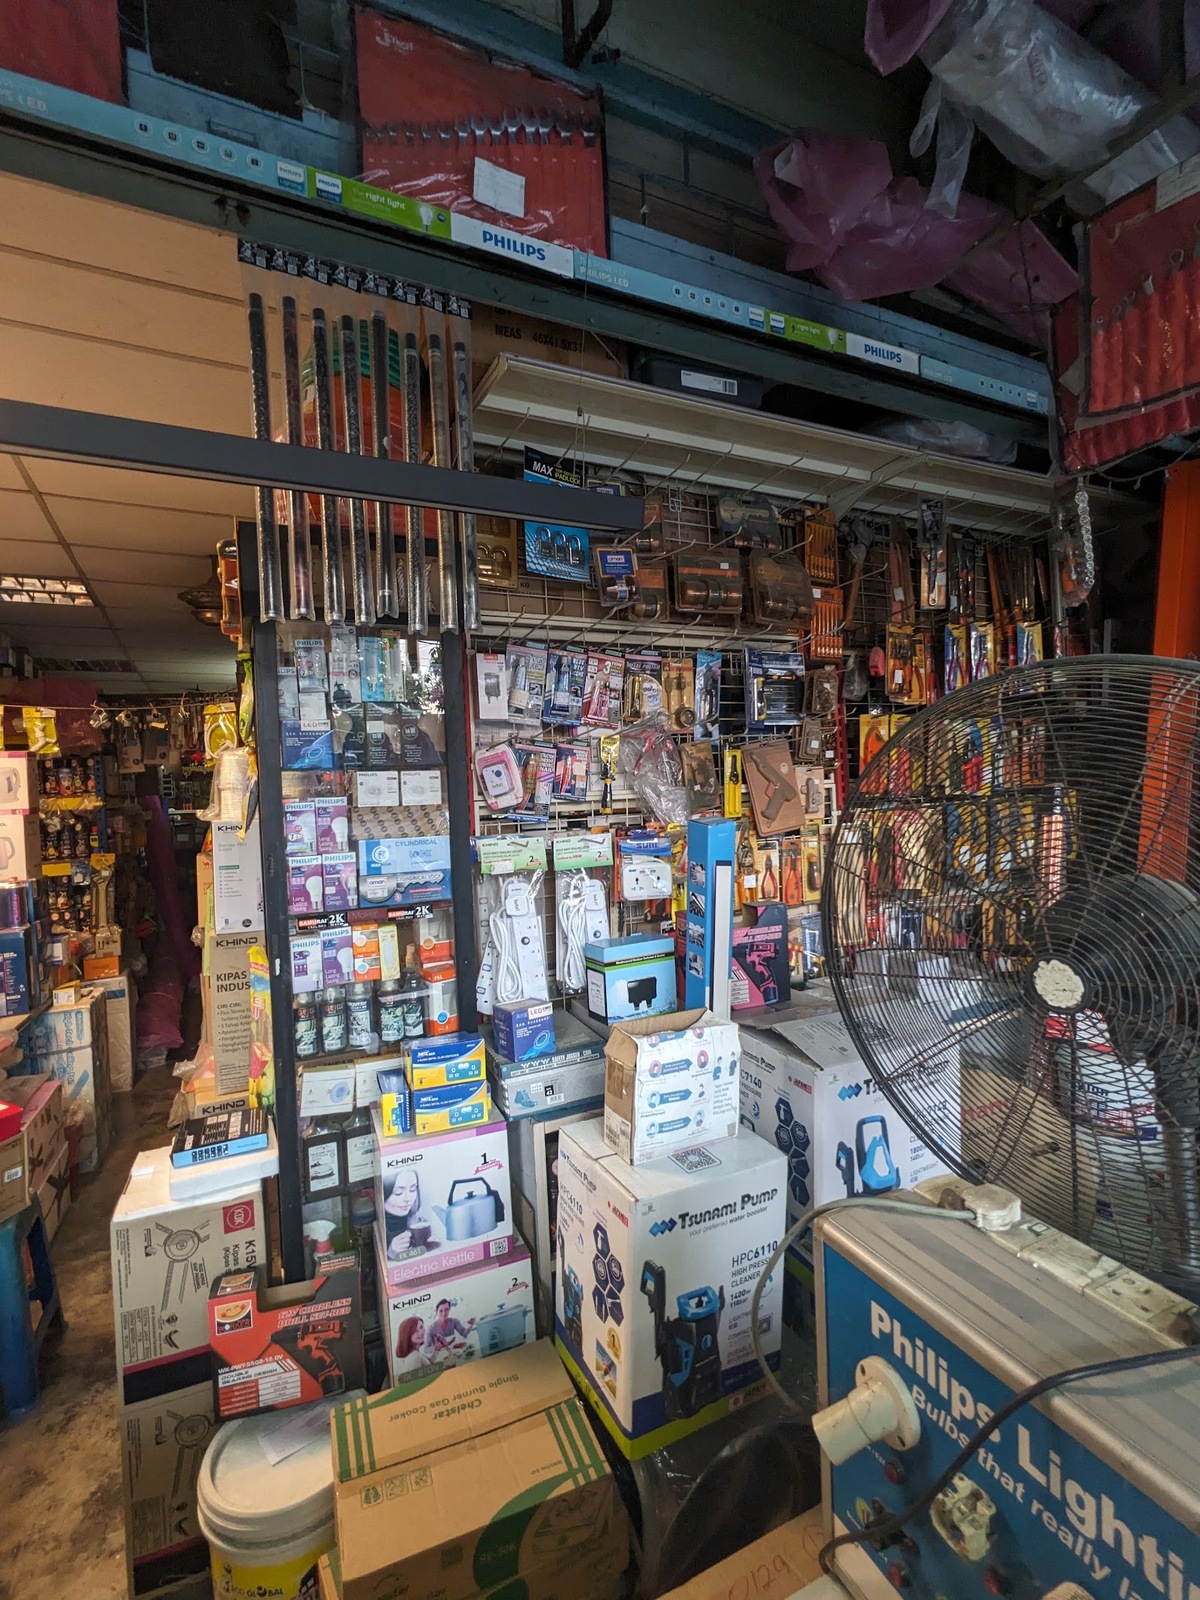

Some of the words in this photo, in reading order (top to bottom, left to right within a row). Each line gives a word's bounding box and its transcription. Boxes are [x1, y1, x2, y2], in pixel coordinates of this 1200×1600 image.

[318, 178, 340, 190] PHILIPS
[365, 191, 386, 205] right
[387, 197, 406, 210] light
[482, 230, 546, 261] PHILIPS
[579, 265, 613, 284] PHILIPS
[613, 275, 630, 288] LED
[495, 323, 522, 340] MEAS
[864, 343, 902, 364] PHILIPS
[532, 461, 554, 476] MAX
[554, 472, 581, 485] PADLOCK
[603, 660, 611, 674] 3
[285, 803, 314, 811] PHILIPS
[394, 838, 438, 847] CYLINDRICAL
[324, 854, 354, 863] PHILIPS
[529, 855, 535, 863] 2
[387, 910, 415, 918] SAMURAI
[415, 905, 430, 915] 2K
[298, 917, 329, 927] SAMURAI
[328, 913, 345, 924] 2K
[322, 929, 350, 938] PHILIPS
[216, 937, 258, 947] KHIND
[292, 940, 320, 949] PHILIPS
[216, 970, 247, 982] KIPAS
[216, 980, 252, 993] INDUS
[529, 1008, 543, 1016] LED
[221, 1034, 250, 1043] Penghantar
[740, 1069, 762, 1089] C7140
[202, 1100, 246, 1115] KHIND
[387, 1154, 424, 1168] KHIND
[480, 1153, 490, 1166] 1
[909, 1160, 940, 1177] LIGHTWEIGHT
[559, 1182, 583, 1215] HPC6110
[234, 1208, 245, 1226] KDK
[688, 1227, 702, 1237] your
[702, 1219, 729, 1234] preferred
[728, 1213, 746, 1225] water
[746, 1206, 768, 1219] booster
[222, 1246, 231, 1269] (Kipas
[232, 1243, 240, 1267] Kipas
[245, 1239, 258, 1271] K15V
[399, 1252, 408, 1260] EK
[408, 1248, 422, 1257] 461
[731, 1240, 779, 1268] HPC6110
[393, 1260, 438, 1281] Electric
[442, 1250, 475, 1268] Kettle
[731, 1264, 748, 1279] HIGH
[748, 1256, 772, 1272] PRESS
[511, 1277, 519, 1288] 2
[730, 1270, 761, 1288] CLEANER
[299, 1298, 351, 1314] CORDLESS
[392, 1293, 432, 1311] KHIND
[277, 1316, 309, 1328] DRILL
[309, 1307, 351, 1323] SET-RED
[221, 1370, 250, 1381] DOUBLE
[221, 1374, 253, 1385] BEARING
[253, 1368, 278, 1379] DESIGN
[870, 1299, 1001, 1443] Philips
[489, 1373, 520, 1389] Single
[452, 1386, 487, 1401] Burner
[429, 1397, 450, 1409] Gas
[432, 1398, 483, 1421] Chelstar
[389, 1405, 428, 1423] Cooker
[911, 1383, 971, 1450] Bulbs
[976, 1448, 1026, 1505] that
[1030, 1497, 1112, 1581] really
